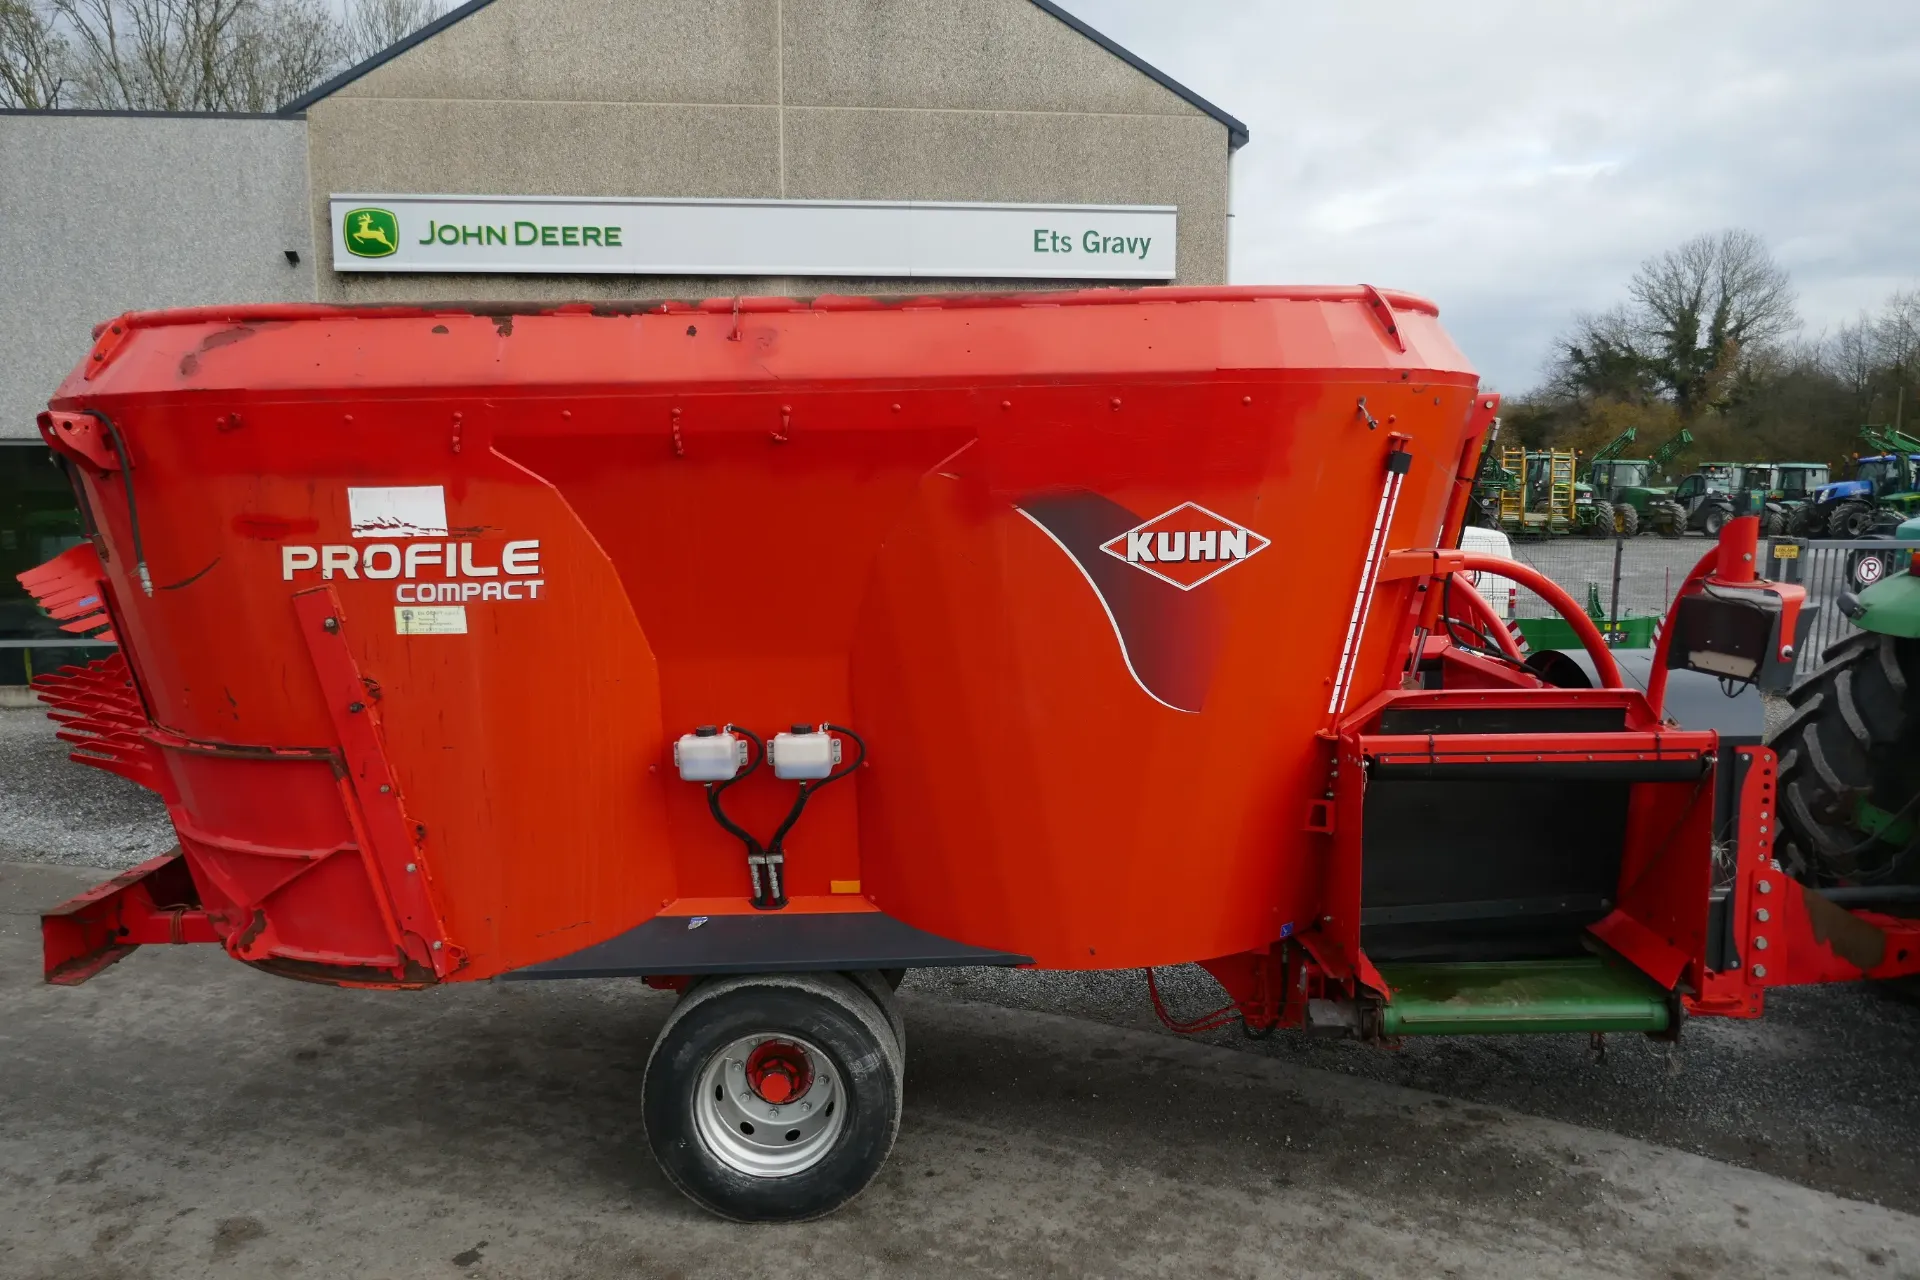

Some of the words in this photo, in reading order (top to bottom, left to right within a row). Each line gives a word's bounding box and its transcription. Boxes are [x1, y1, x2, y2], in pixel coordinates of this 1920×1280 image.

[419, 220, 508, 246] JOHN
[514, 221, 623, 247] DEERE
[1033, 229, 1072, 253] Ets
[1082, 230, 1152, 260] Gravy
[282, 539, 540, 581] PROFILE
[1126, 529, 1248, 563] KUHN
[396, 579, 545, 603] COMPACT
